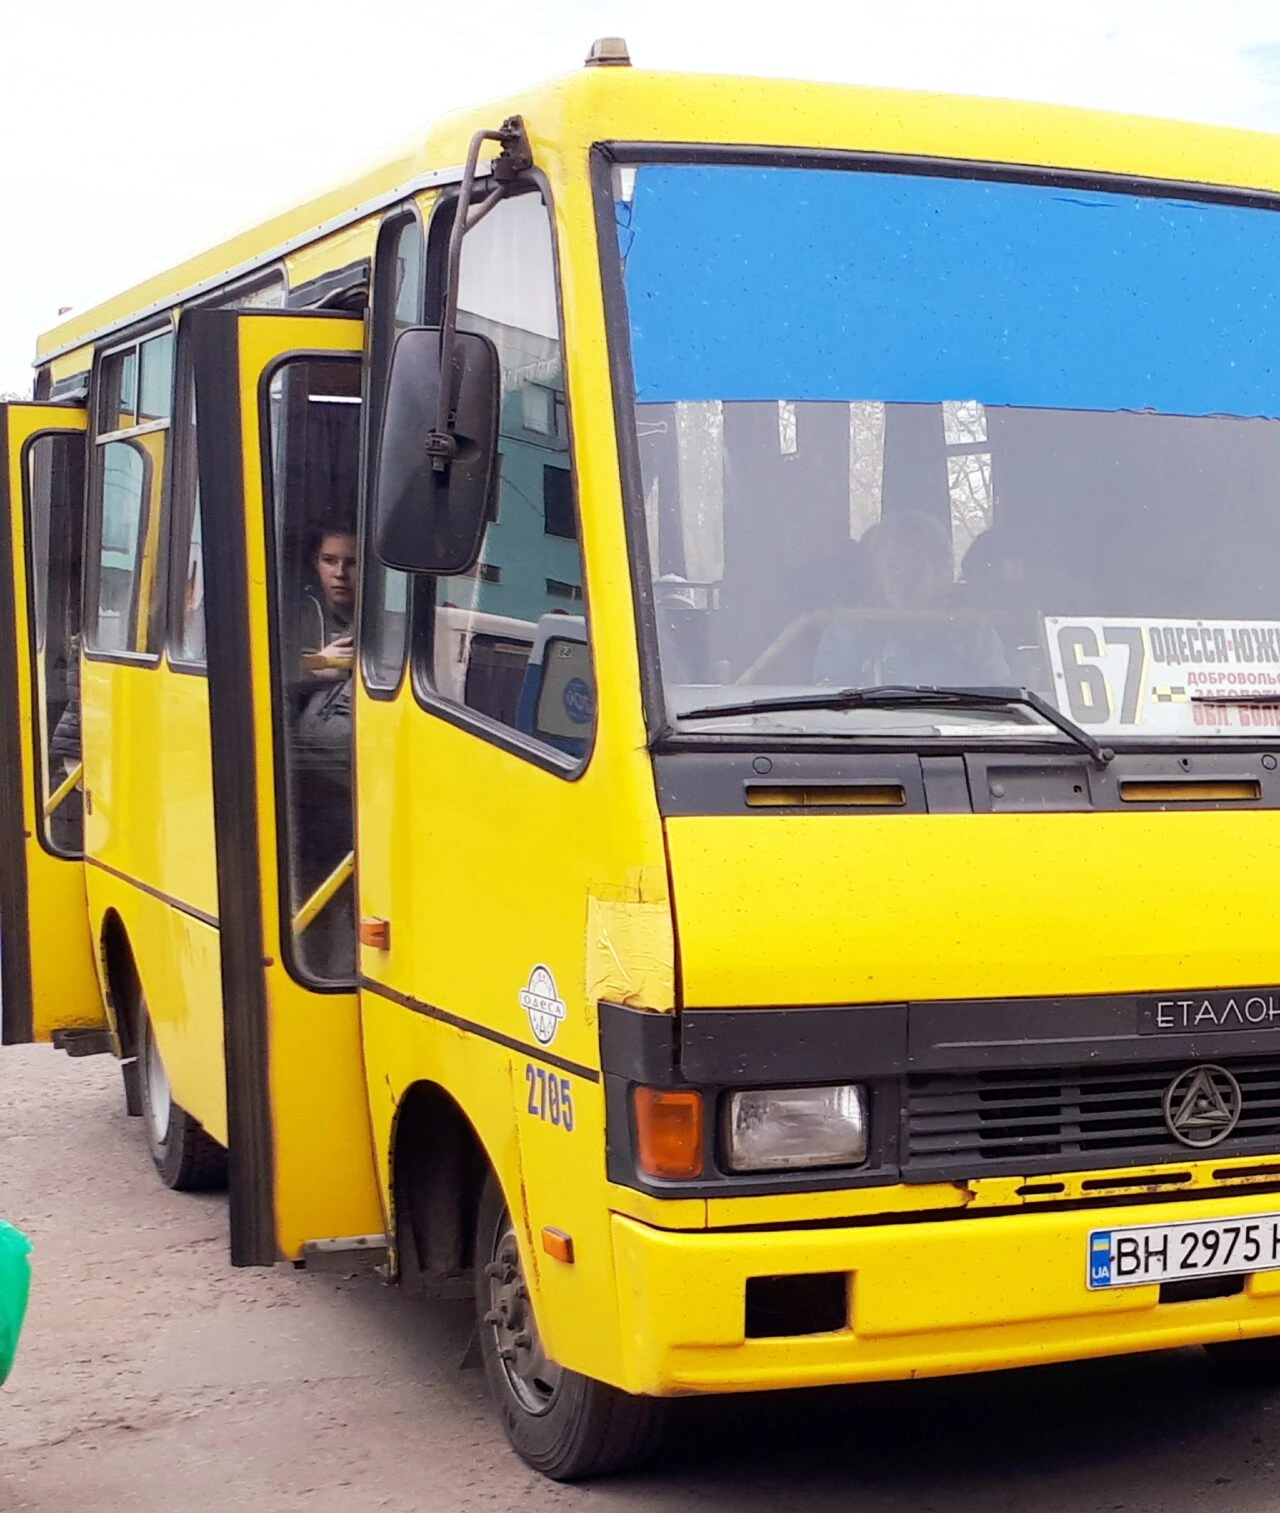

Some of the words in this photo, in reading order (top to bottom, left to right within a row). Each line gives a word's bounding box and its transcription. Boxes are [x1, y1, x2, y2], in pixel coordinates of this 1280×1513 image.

[1057, 626, 1146, 724] 67
[1092, 1265, 1110, 1279] UA
[1117, 1233, 1168, 1276] BH
[1179, 1224, 1261, 1269] 2975
